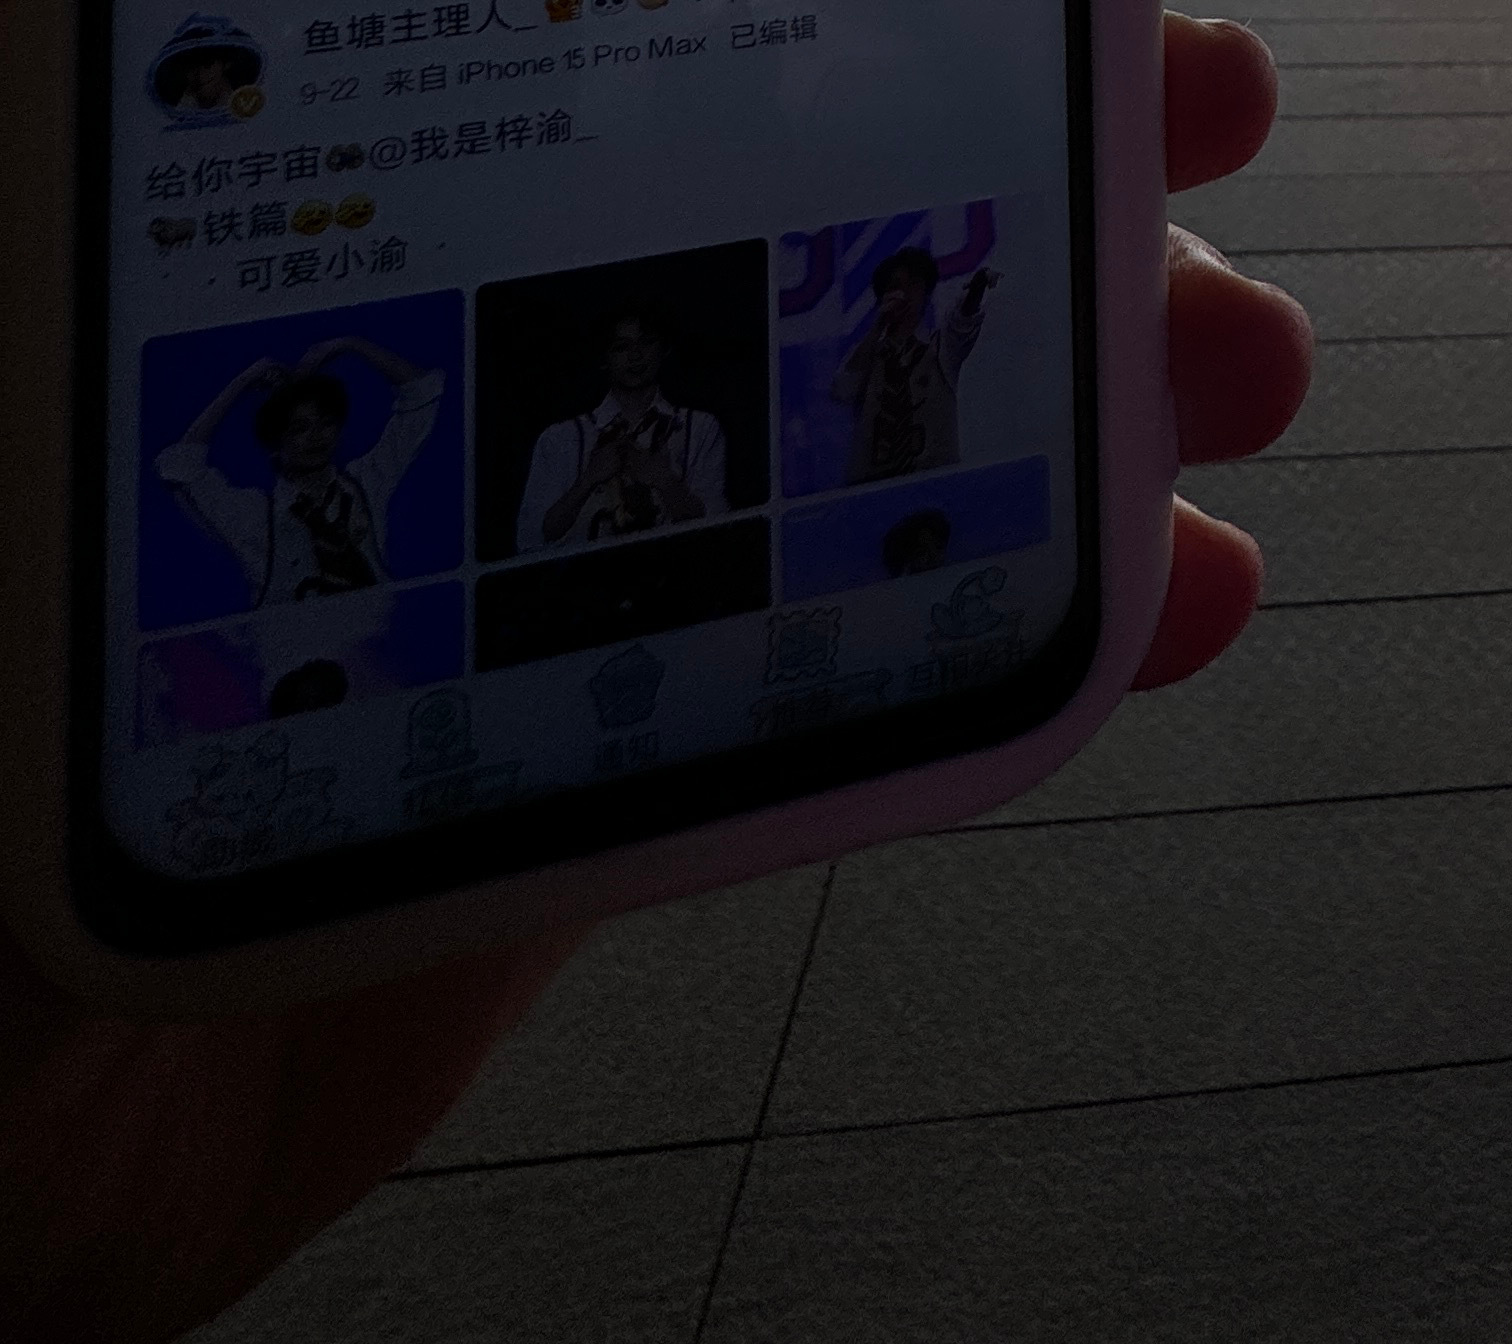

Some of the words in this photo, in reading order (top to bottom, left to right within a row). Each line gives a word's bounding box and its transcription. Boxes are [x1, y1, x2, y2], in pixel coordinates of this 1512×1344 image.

[299, 77, 361, 106] 9-22
[382, 63, 448, 98] 来自
[457, 52, 555, 88] iPhone
[561, 46, 587, 71] 15
[593, 40, 641, 68] Pro
[648, 33, 707, 60] Max
[729, 13, 819, 51] 已编辑
[145, 142, 323, 202] 给你宇宙
[202, 199, 290, 246] 铁篇
[236, 235, 410, 293] 可爱小渝
